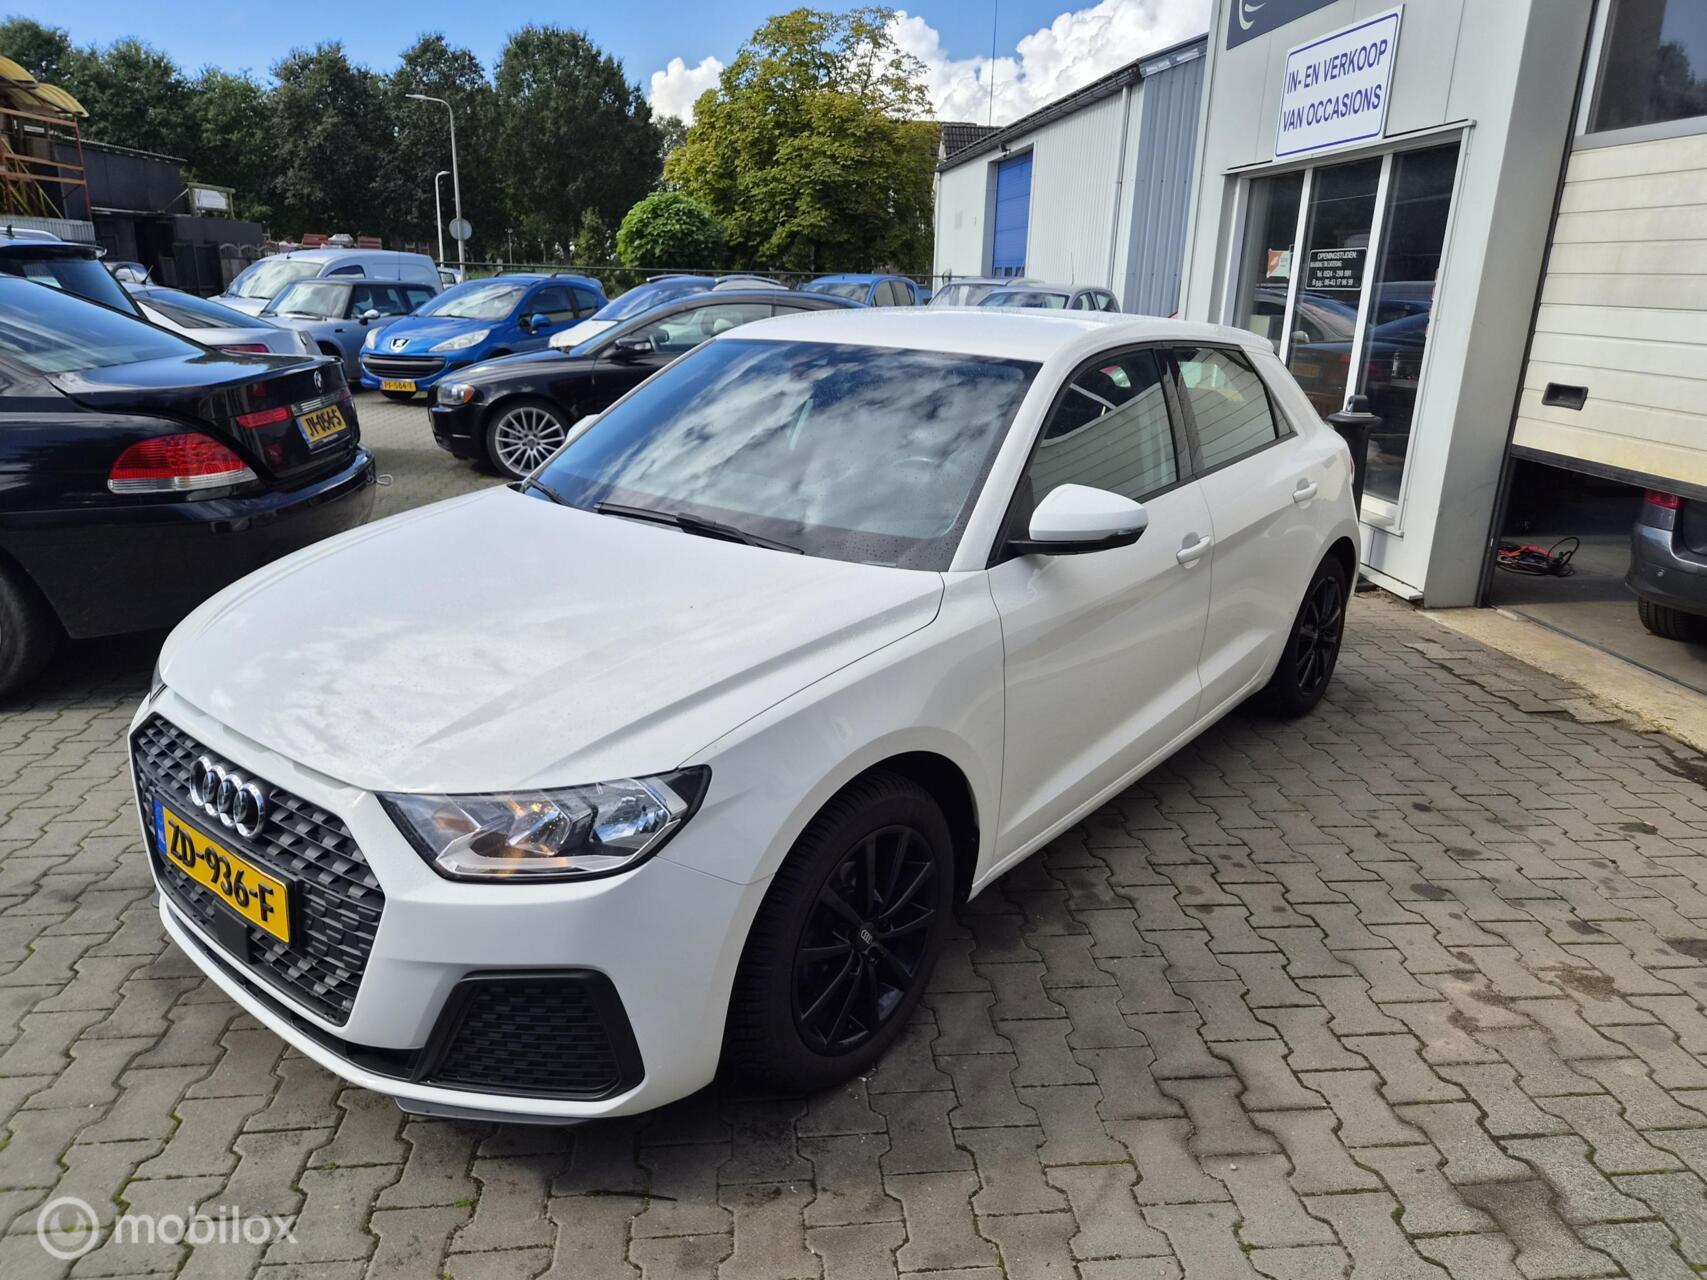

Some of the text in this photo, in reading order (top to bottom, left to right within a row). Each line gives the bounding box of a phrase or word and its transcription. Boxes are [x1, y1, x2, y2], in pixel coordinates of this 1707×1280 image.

[1287, 39, 1388, 94] IN- EN VERKOOP
[1283, 84, 1382, 132] VAN OCCASIONS
[167, 819, 274, 923] ZD-936-F
